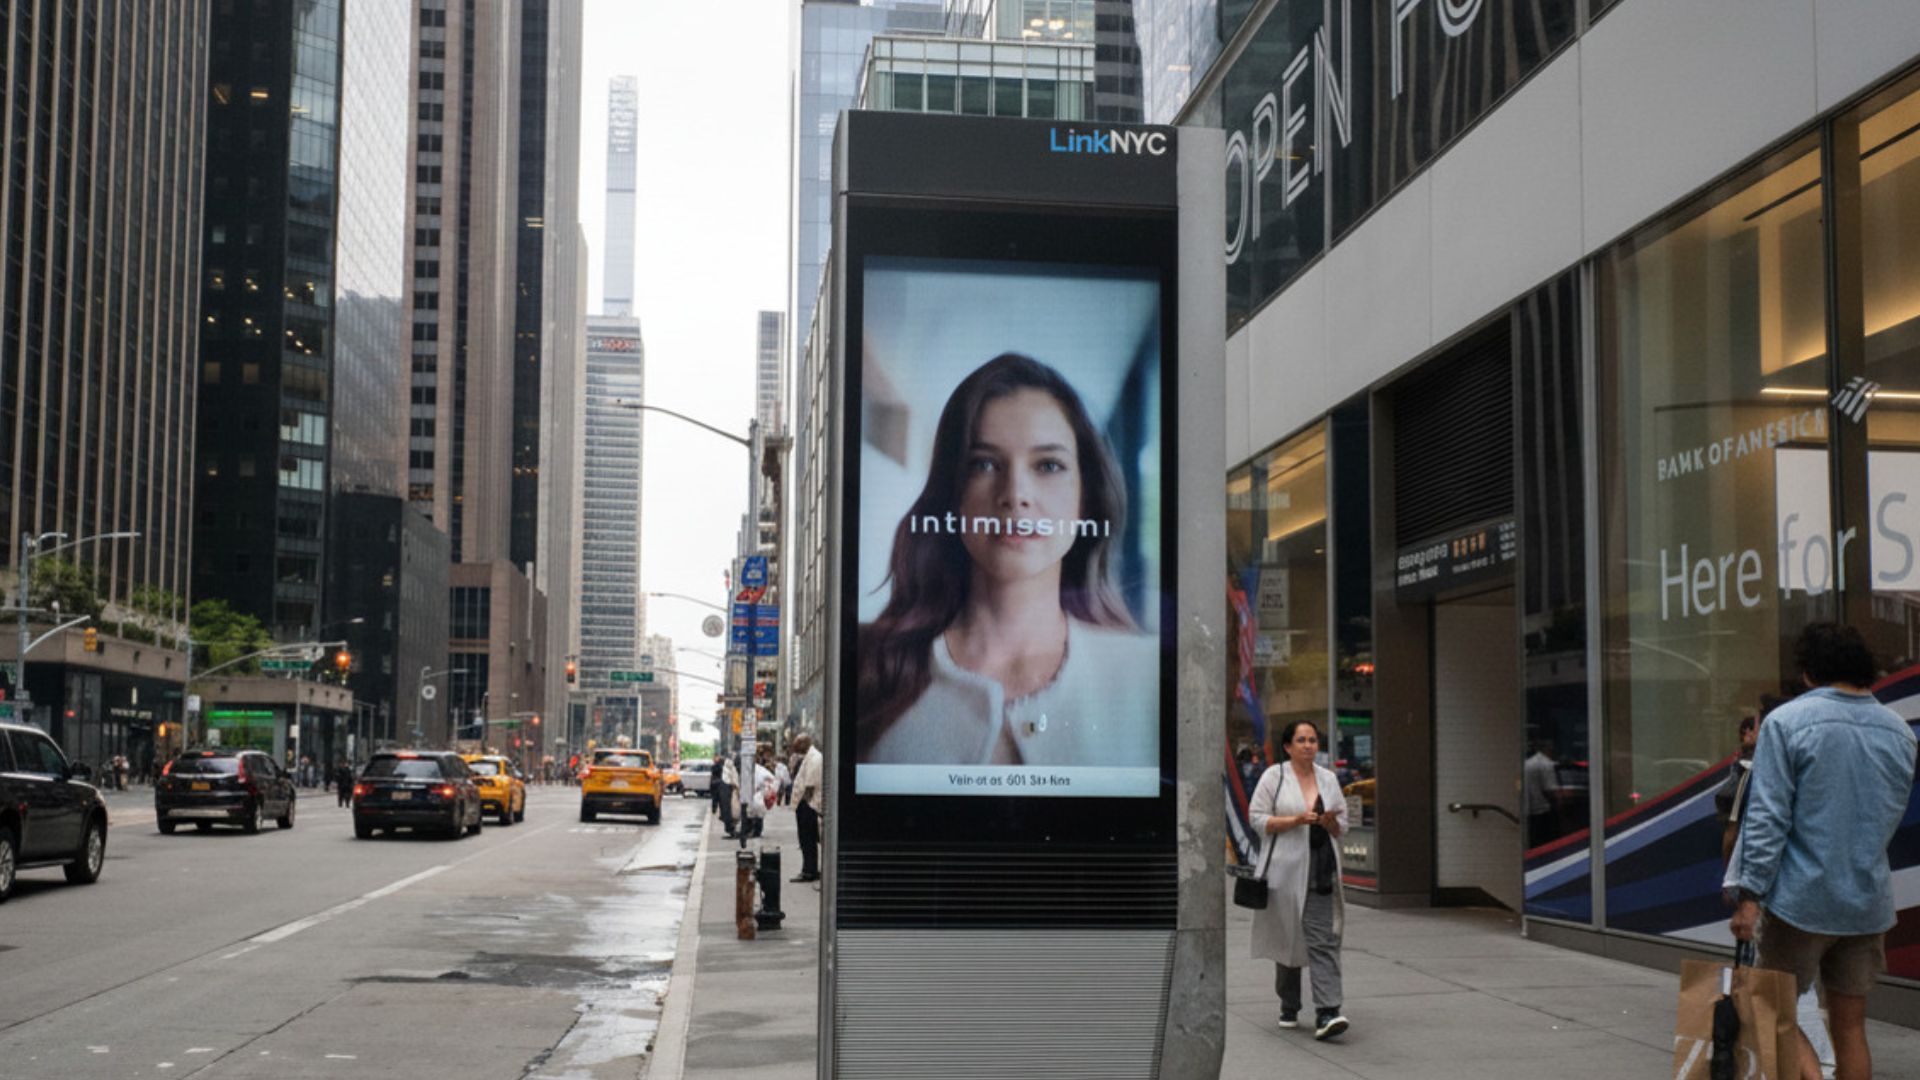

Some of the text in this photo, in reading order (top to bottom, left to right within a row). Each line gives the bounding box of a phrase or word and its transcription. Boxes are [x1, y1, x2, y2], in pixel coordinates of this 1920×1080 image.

[1050, 128, 1167, 156] LinkNYC
[1226, 0, 1352, 264] OPEN
[911, 511, 1111, 538] intimissimi
[1660, 543, 1763, 621] Here
[1778, 512, 1857, 600] for
